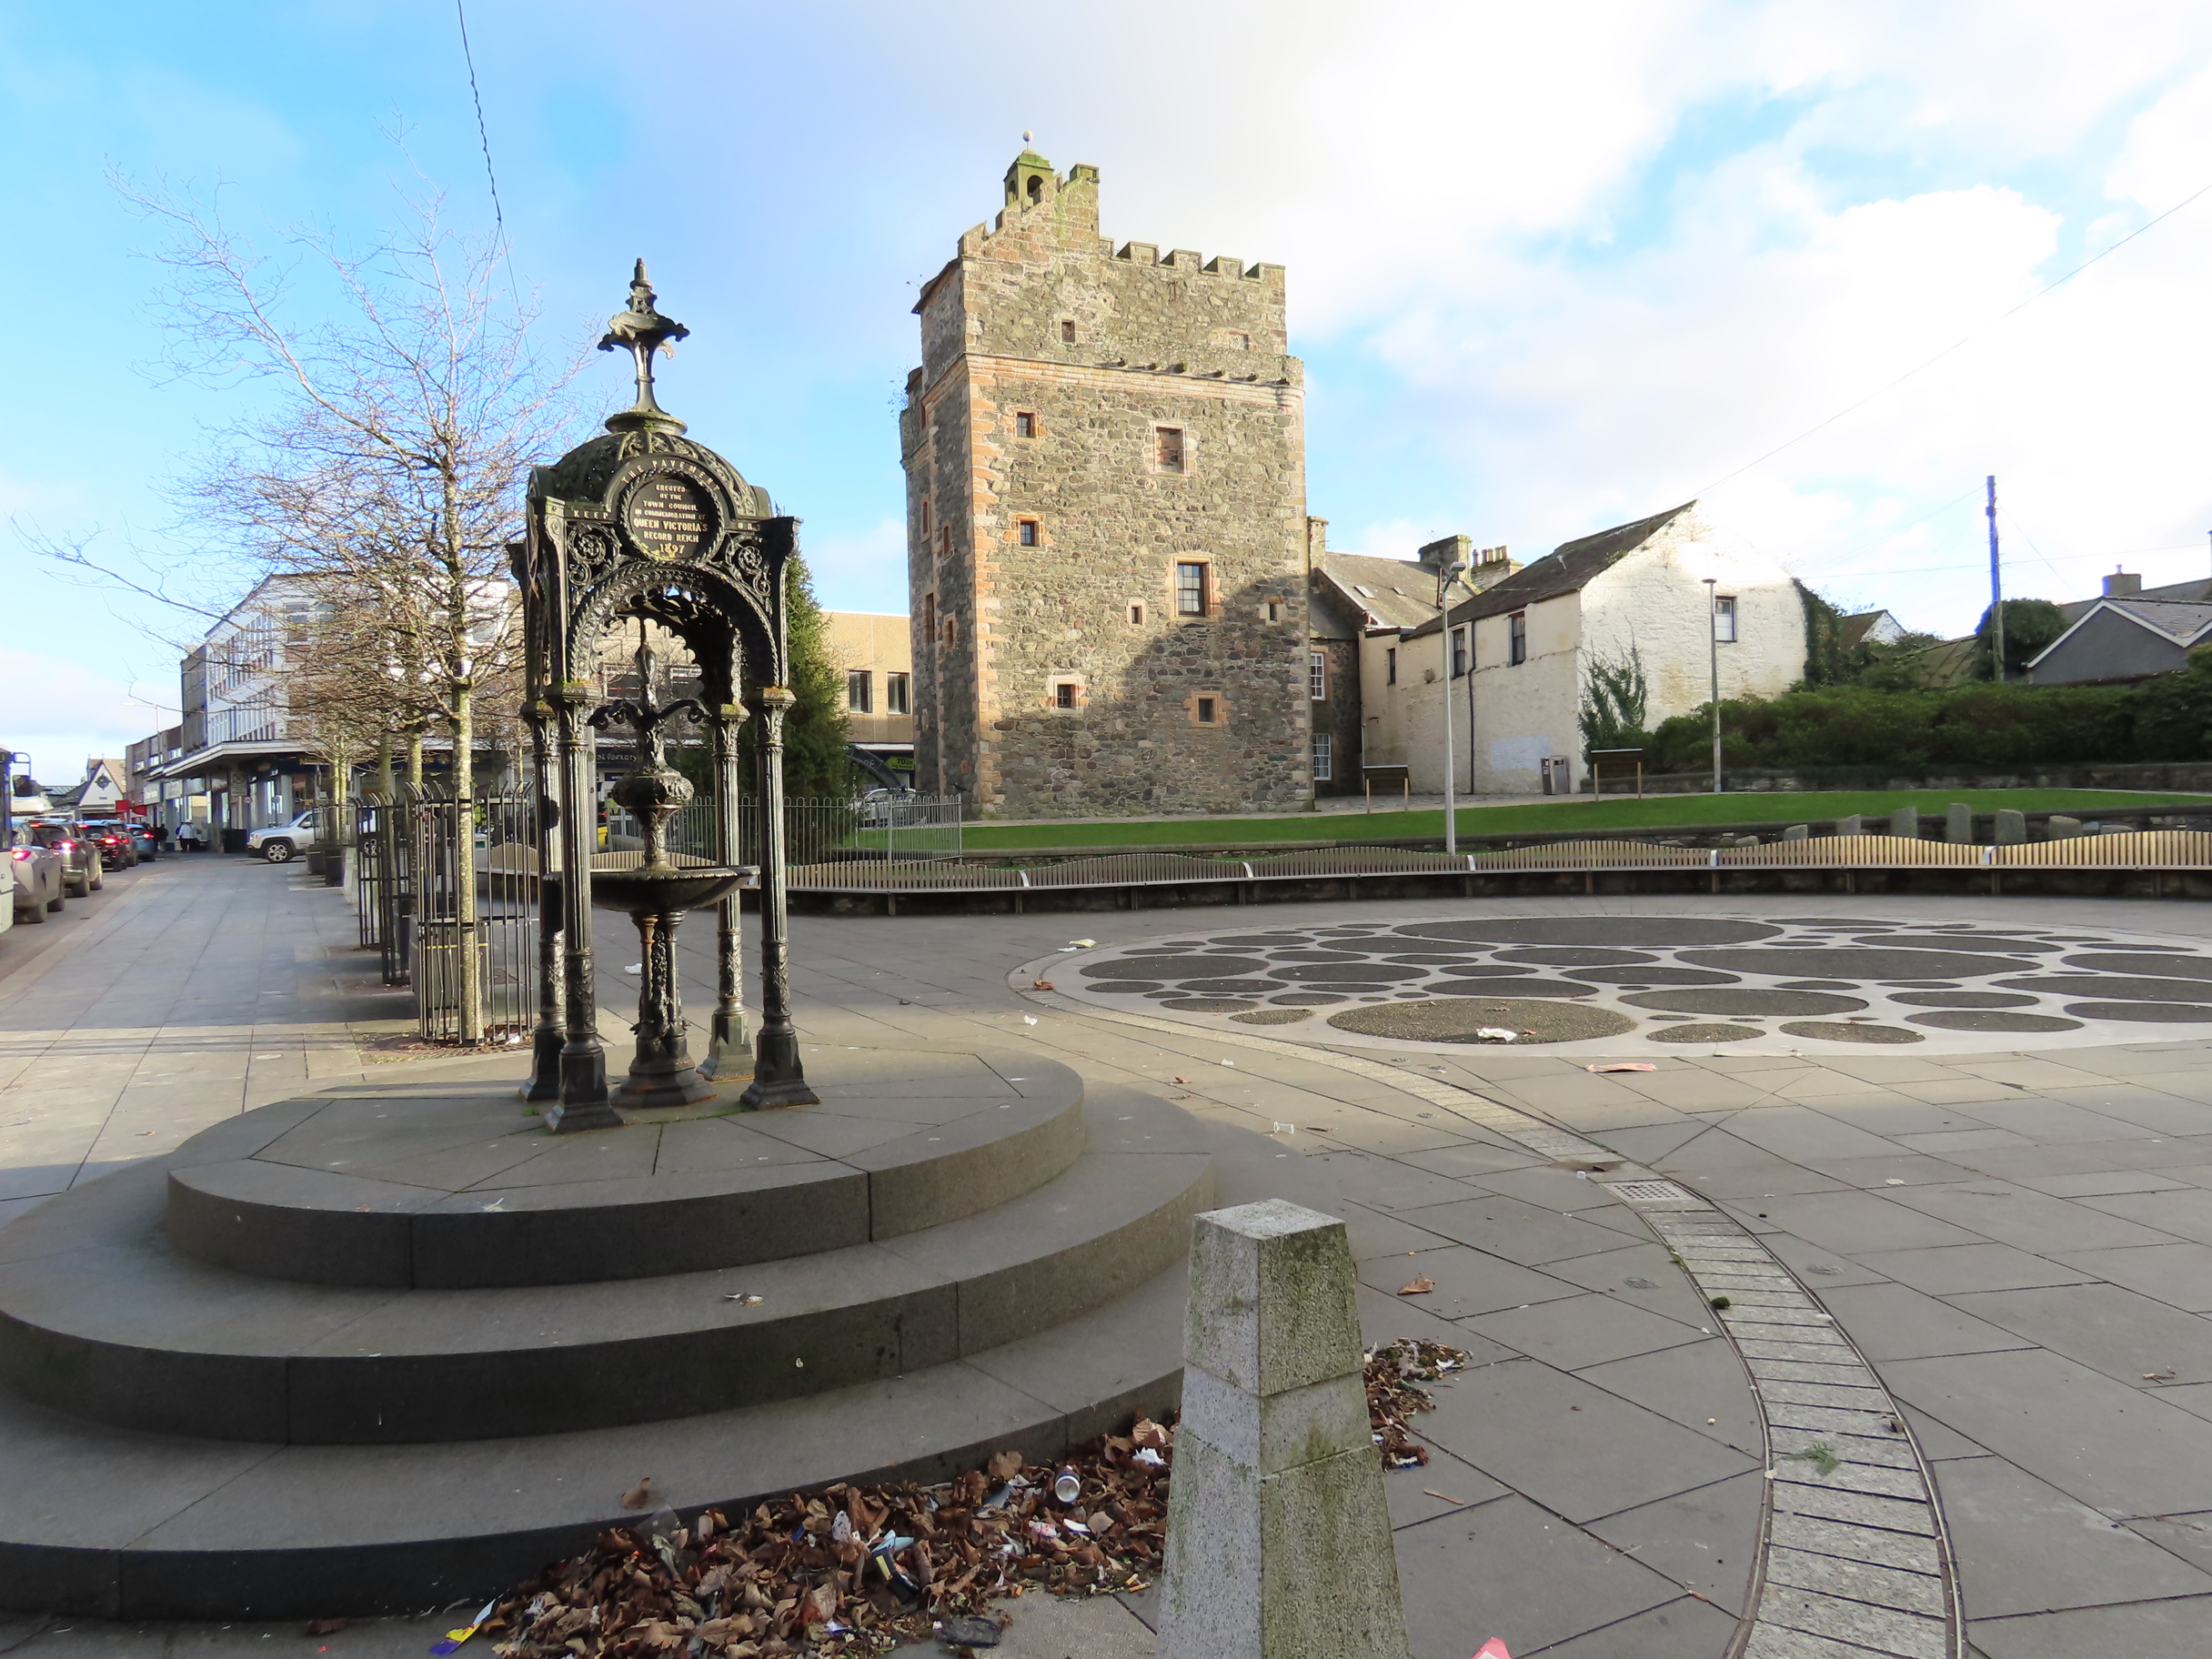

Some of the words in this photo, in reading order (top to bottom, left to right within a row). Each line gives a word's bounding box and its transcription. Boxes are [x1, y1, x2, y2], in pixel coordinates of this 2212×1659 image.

[574, 509, 608, 519] KEEP
[621, 465, 644, 484] THE
[651, 458, 721, 491] PAVEMENT
[656, 484, 687, 492] ERECTED
[642, 500, 664, 508] TOWN
[669, 503, 699, 511] COUNCIL
[644, 509, 696, 519] COMMEMORATION
[633, 518, 659, 528] QUEEN
[662, 519, 709, 532] VICTORIA'S
[643, 530, 672, 541] RECORD
[676, 533, 699, 543] REIGN
[659, 543, 685, 554] 1897
[607, 753, 638, 762] factory
